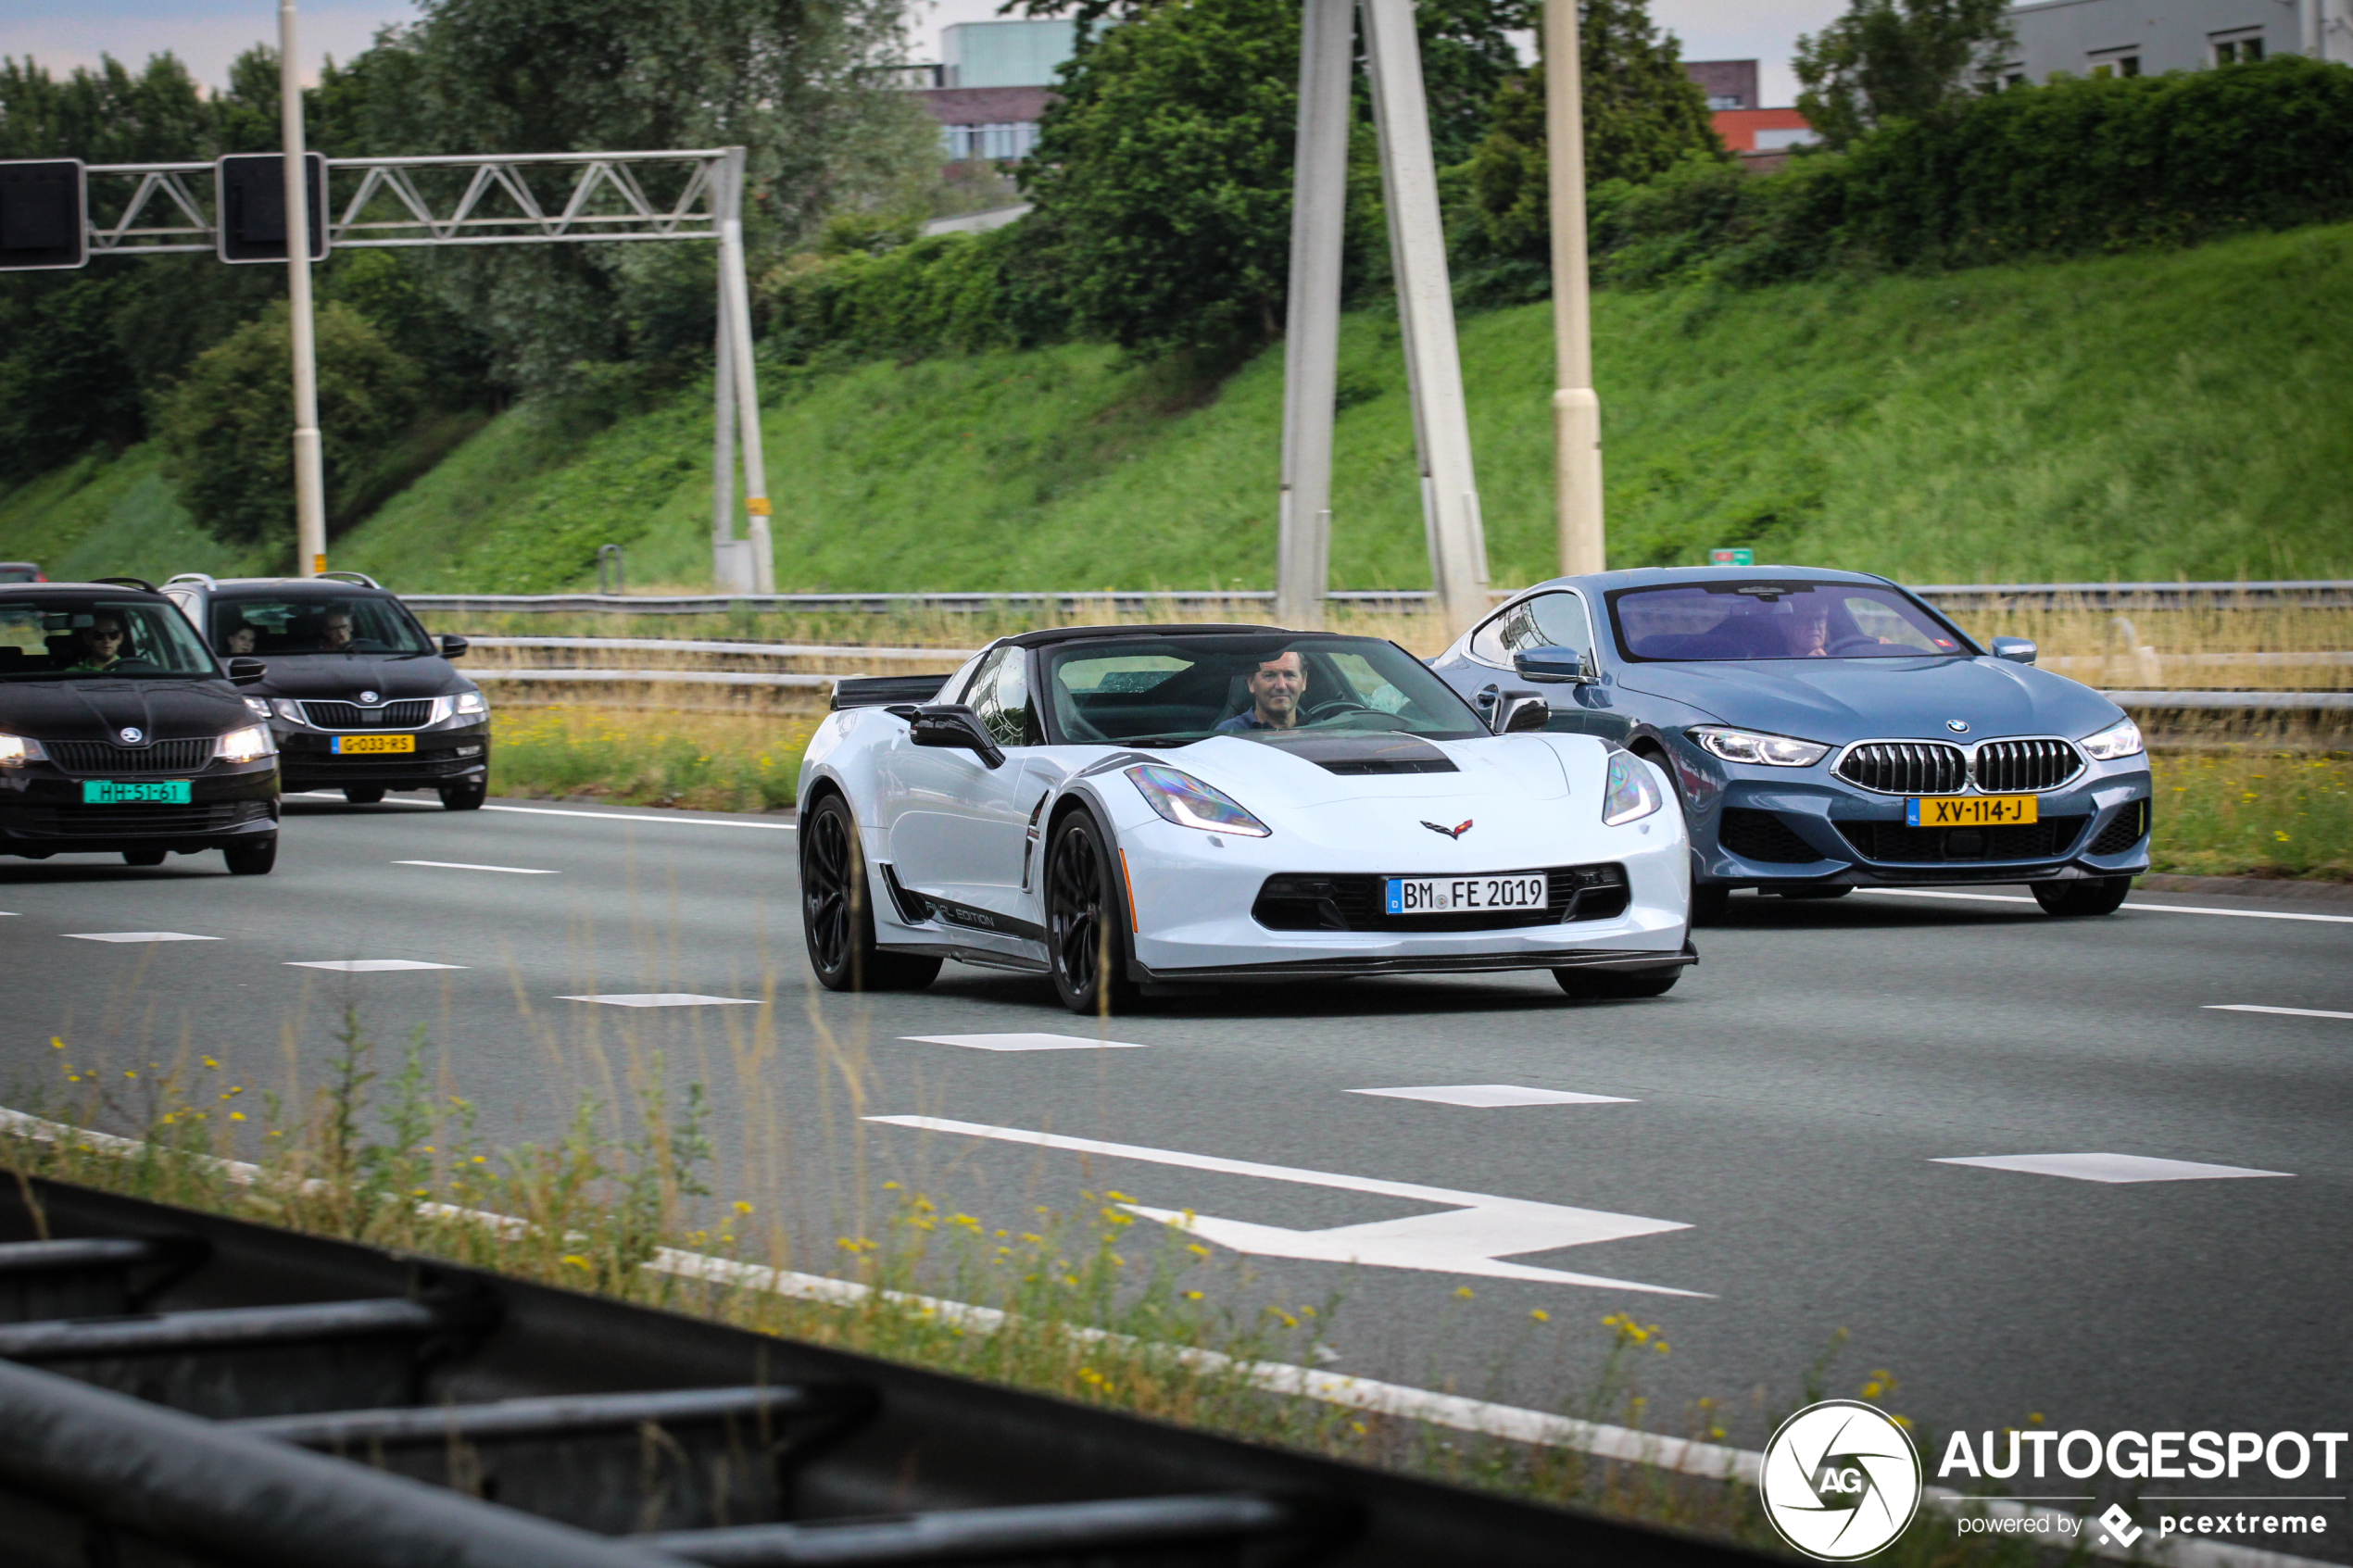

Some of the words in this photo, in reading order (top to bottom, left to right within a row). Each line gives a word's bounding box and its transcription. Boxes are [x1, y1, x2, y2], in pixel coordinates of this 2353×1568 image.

[344, 737, 409, 751] G-033-RS
[100, 784, 178, 800] HH-51-61
[1936, 800, 2022, 822] XV-114-J
[1403, 882, 1433, 909] BM
[1452, 881, 1480, 908] FE
[1487, 879, 1542, 907] 2019
[1391, 900, 1399, 909] D
[955, 908, 995, 927] EDITION
